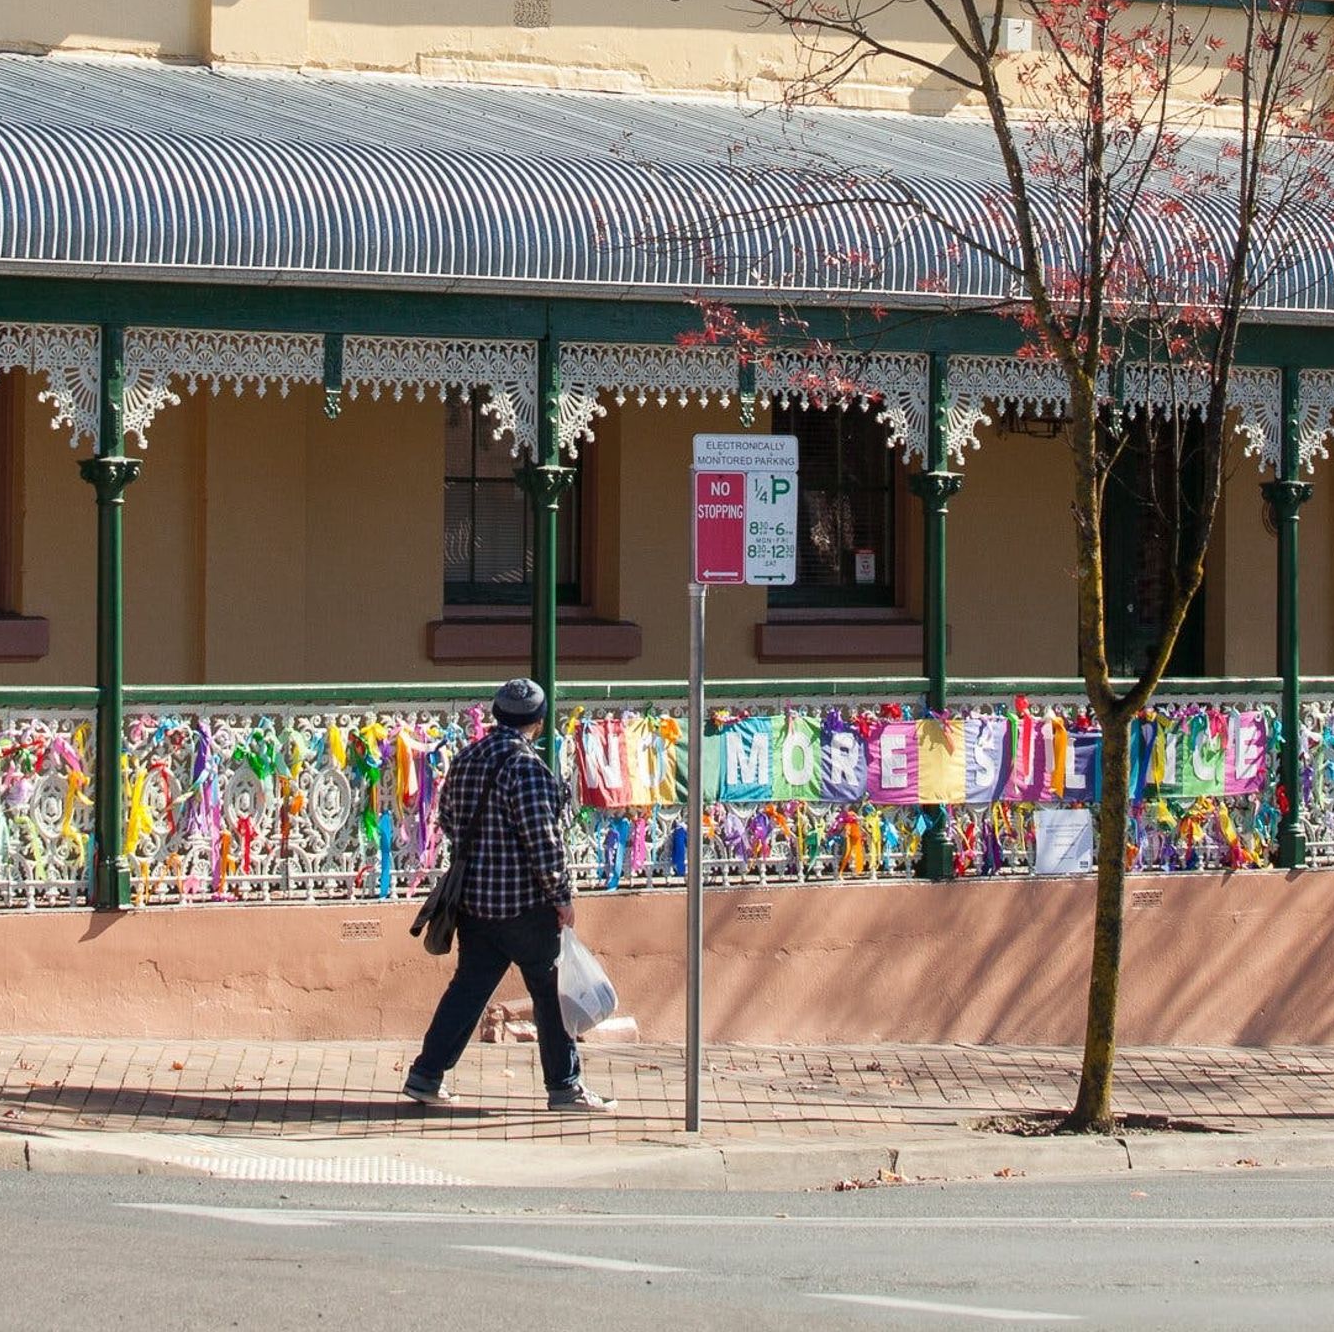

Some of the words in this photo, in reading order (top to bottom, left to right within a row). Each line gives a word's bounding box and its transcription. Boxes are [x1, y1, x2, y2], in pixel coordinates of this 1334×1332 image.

[705, 441, 785, 451] ELECTRONICALLY
[697, 456, 753, 465] MONITORED
[754, 456, 795, 466] PARKING
[710, 481, 731, 497] NO
[771, 478, 791, 505] P
[698, 504, 744, 519] STOPPING
[725, 731, 909, 789] MORE
